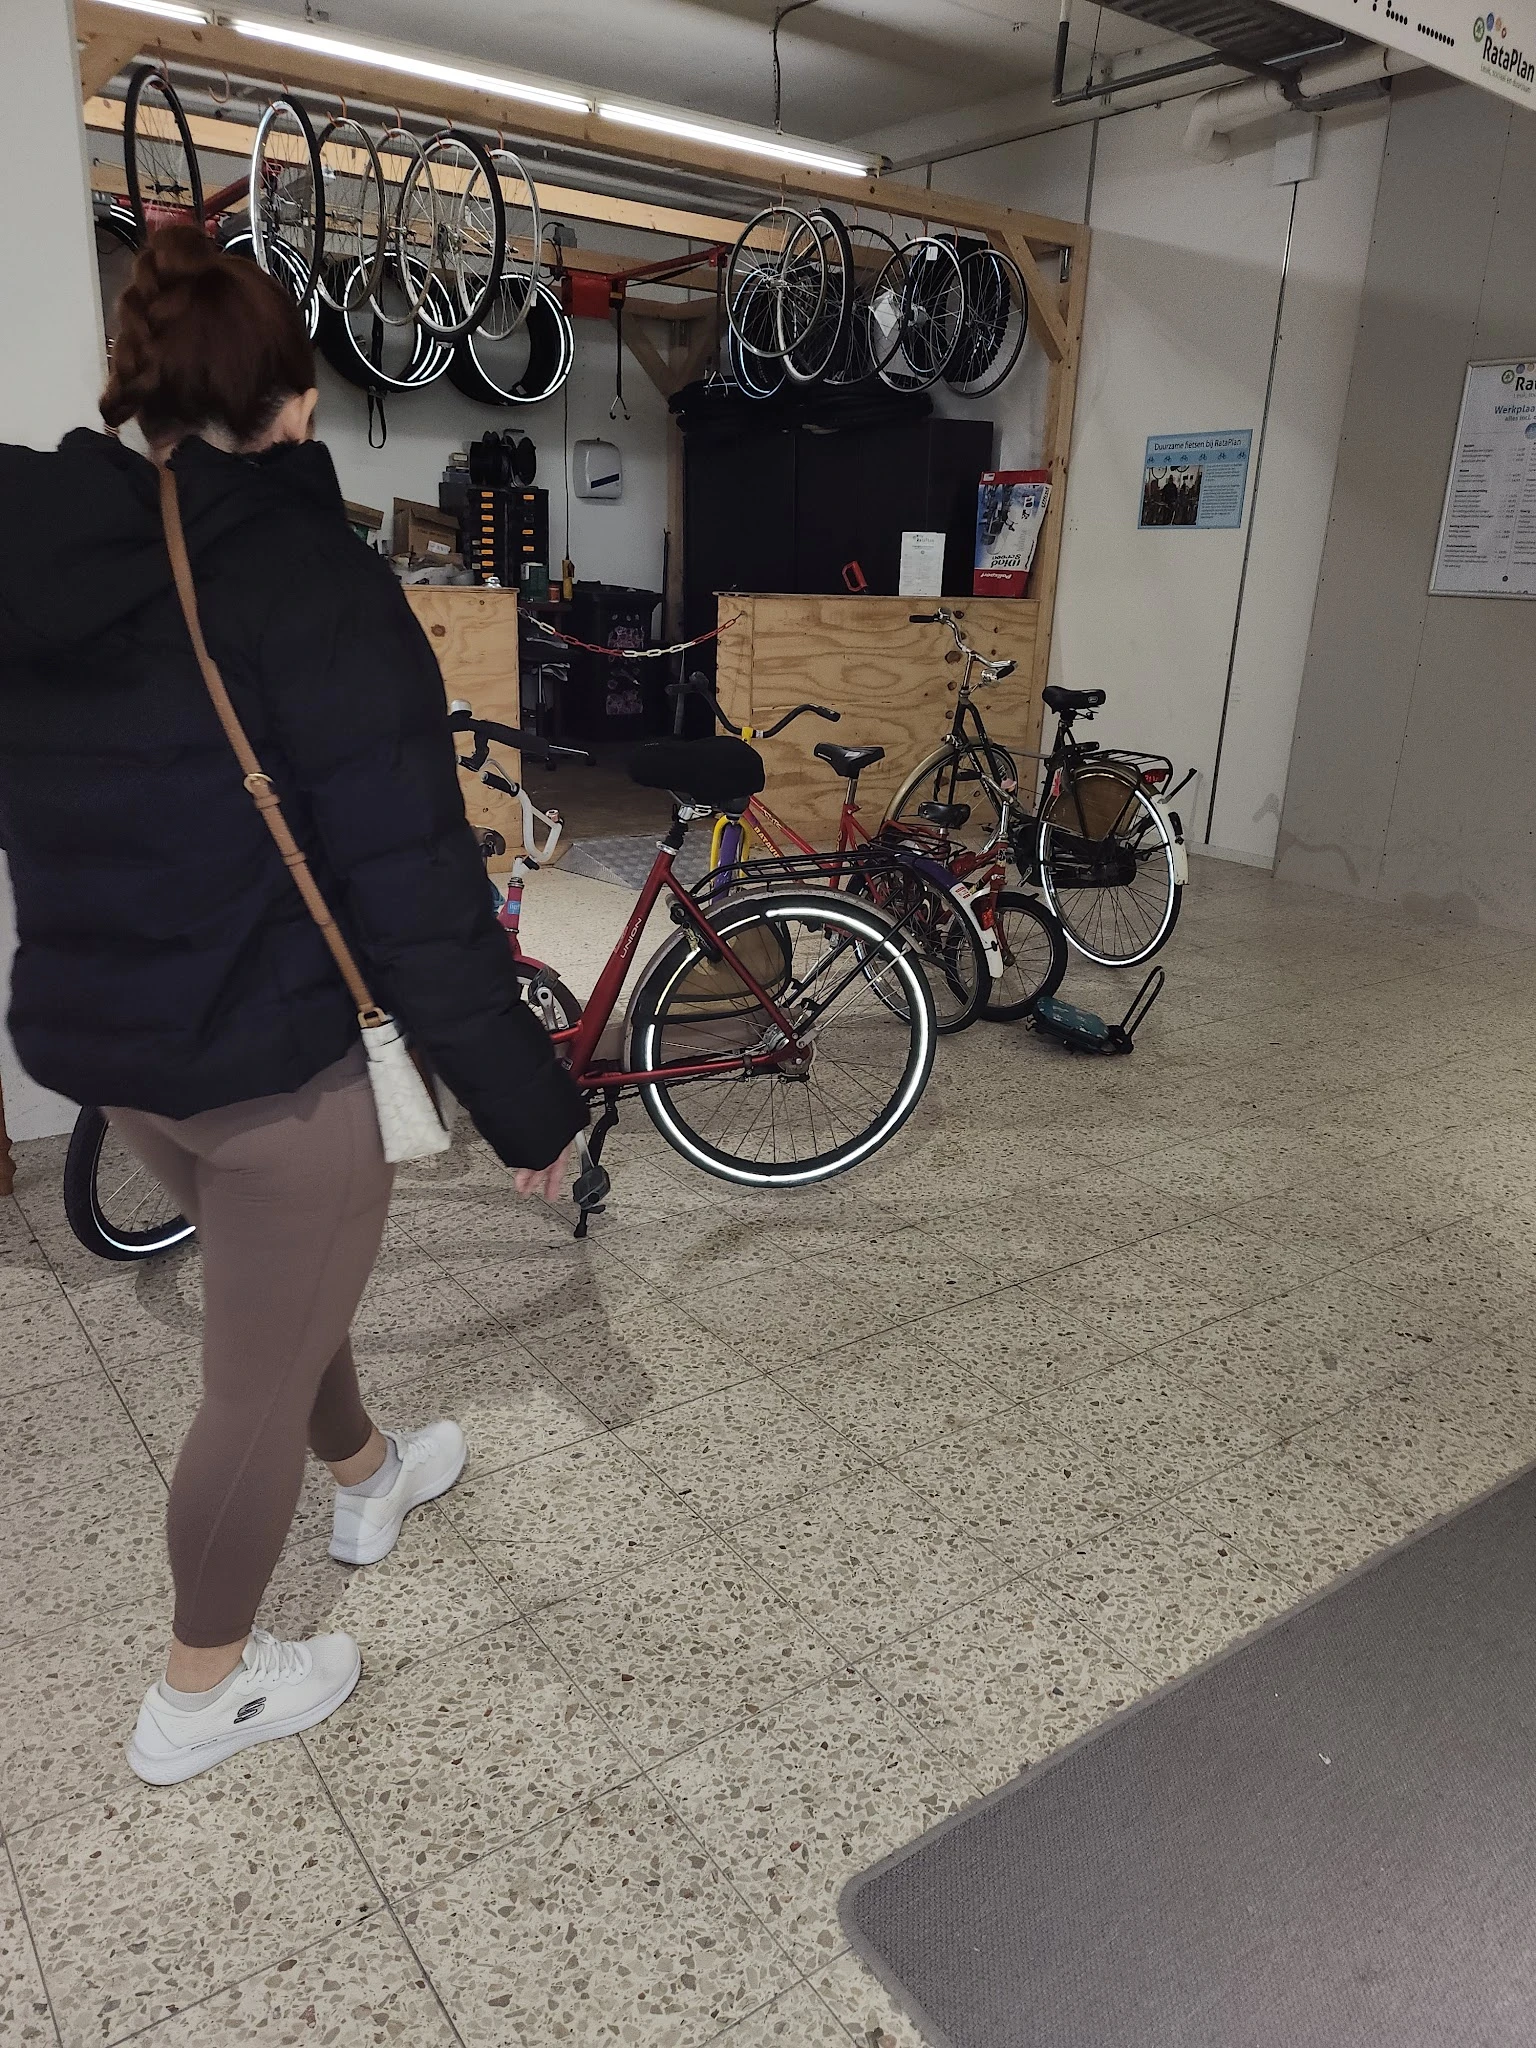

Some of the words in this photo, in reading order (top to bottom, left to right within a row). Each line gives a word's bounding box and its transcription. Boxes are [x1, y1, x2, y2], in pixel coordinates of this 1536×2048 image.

[1482, 35, 1535, 83] RataPlan
[1515, 376, 1536, 391] Ra
[1154, 442, 1184, 451] Duurzame
[1185, 440, 1205, 449] fietsen
[1205, 439, 1213, 449] bij
[1214, 438, 1242, 447] RataPlan
[620, 917, 643, 959] UNION
